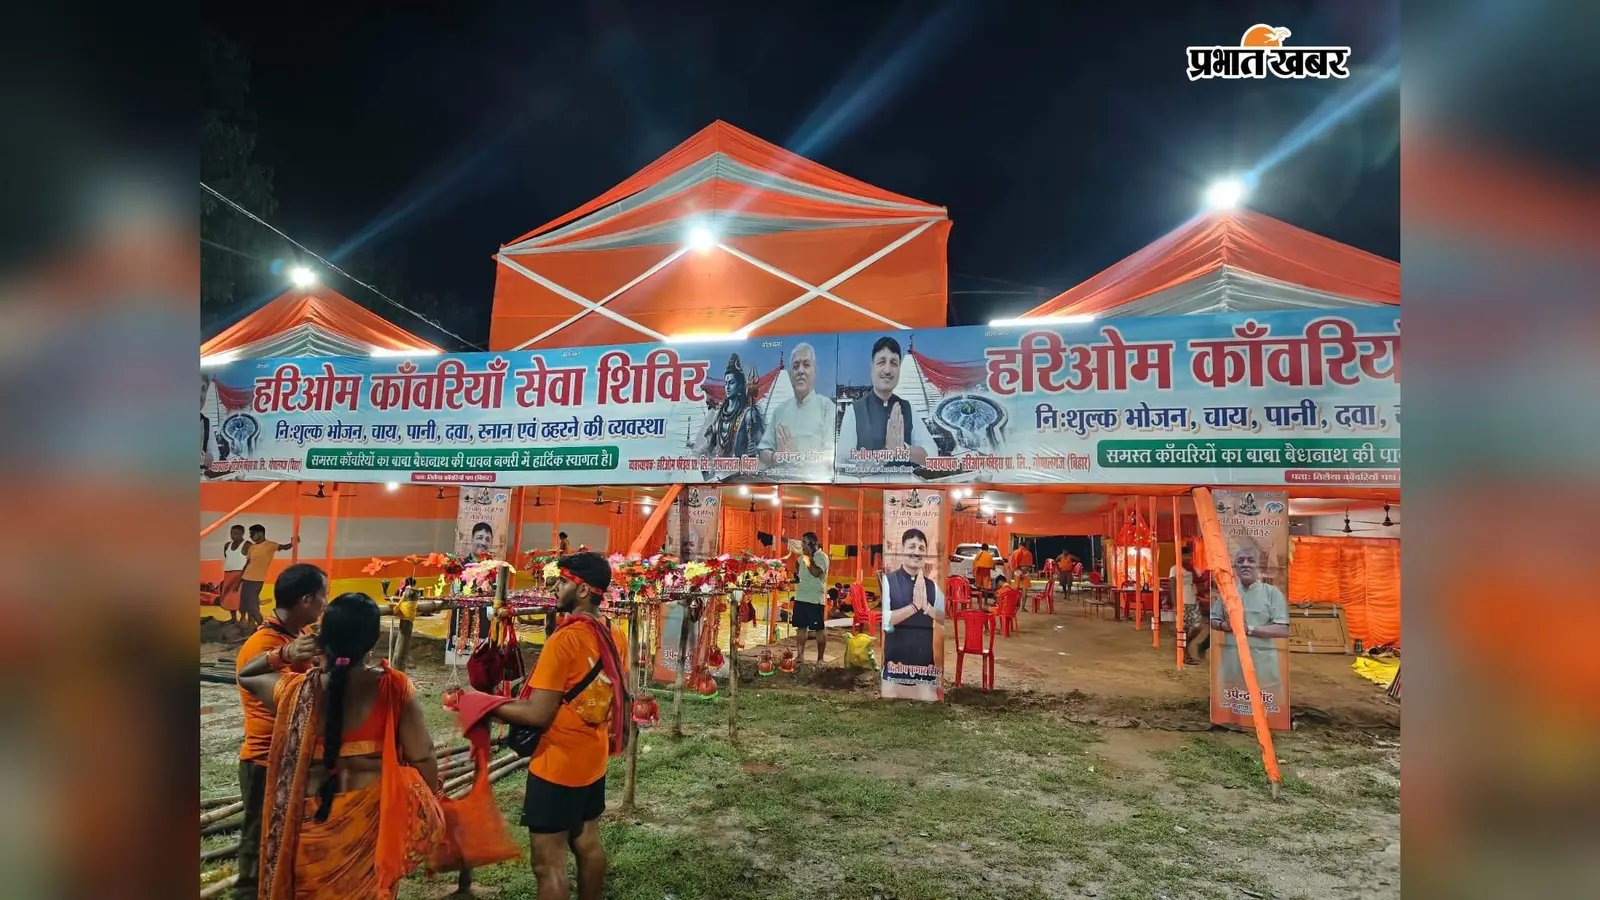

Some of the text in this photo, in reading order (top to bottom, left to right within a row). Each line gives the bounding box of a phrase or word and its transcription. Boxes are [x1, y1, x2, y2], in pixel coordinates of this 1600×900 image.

[986, 327, 1174, 395] हरिओम
[253, 349, 710, 413] हरिओम काँवरियाँ सेवा शिविर
[275, 414, 665, 445] नि:शुल्क भोजन, चाय, पानी, दवा, स्नान एवं ठहरने की व्यवस्था
[1035, 398, 1387, 436] नि:शुल्क भोजन, चाय, पानी, दवा,
[311, 453, 338, 467] समस्त
[377, 454, 390, 467] का
[391, 454, 412, 468] बाबा
[451, 451, 464, 468] की
[466, 454, 492, 468] पावन
[494, 451, 519, 468] नगरी
[520, 450, 531, 468] में
[532, 450, 564, 468] हार्दिक
[565, 453, 600, 468] स्वागत
[1106, 448, 1152, 463] समस्त
[1155, 442, 1218, 463] काँवरियों
[1221, 448, 1242, 463] का
[1246, 448, 1281, 463] बाबा
[1352, 442, 1376, 463] की
